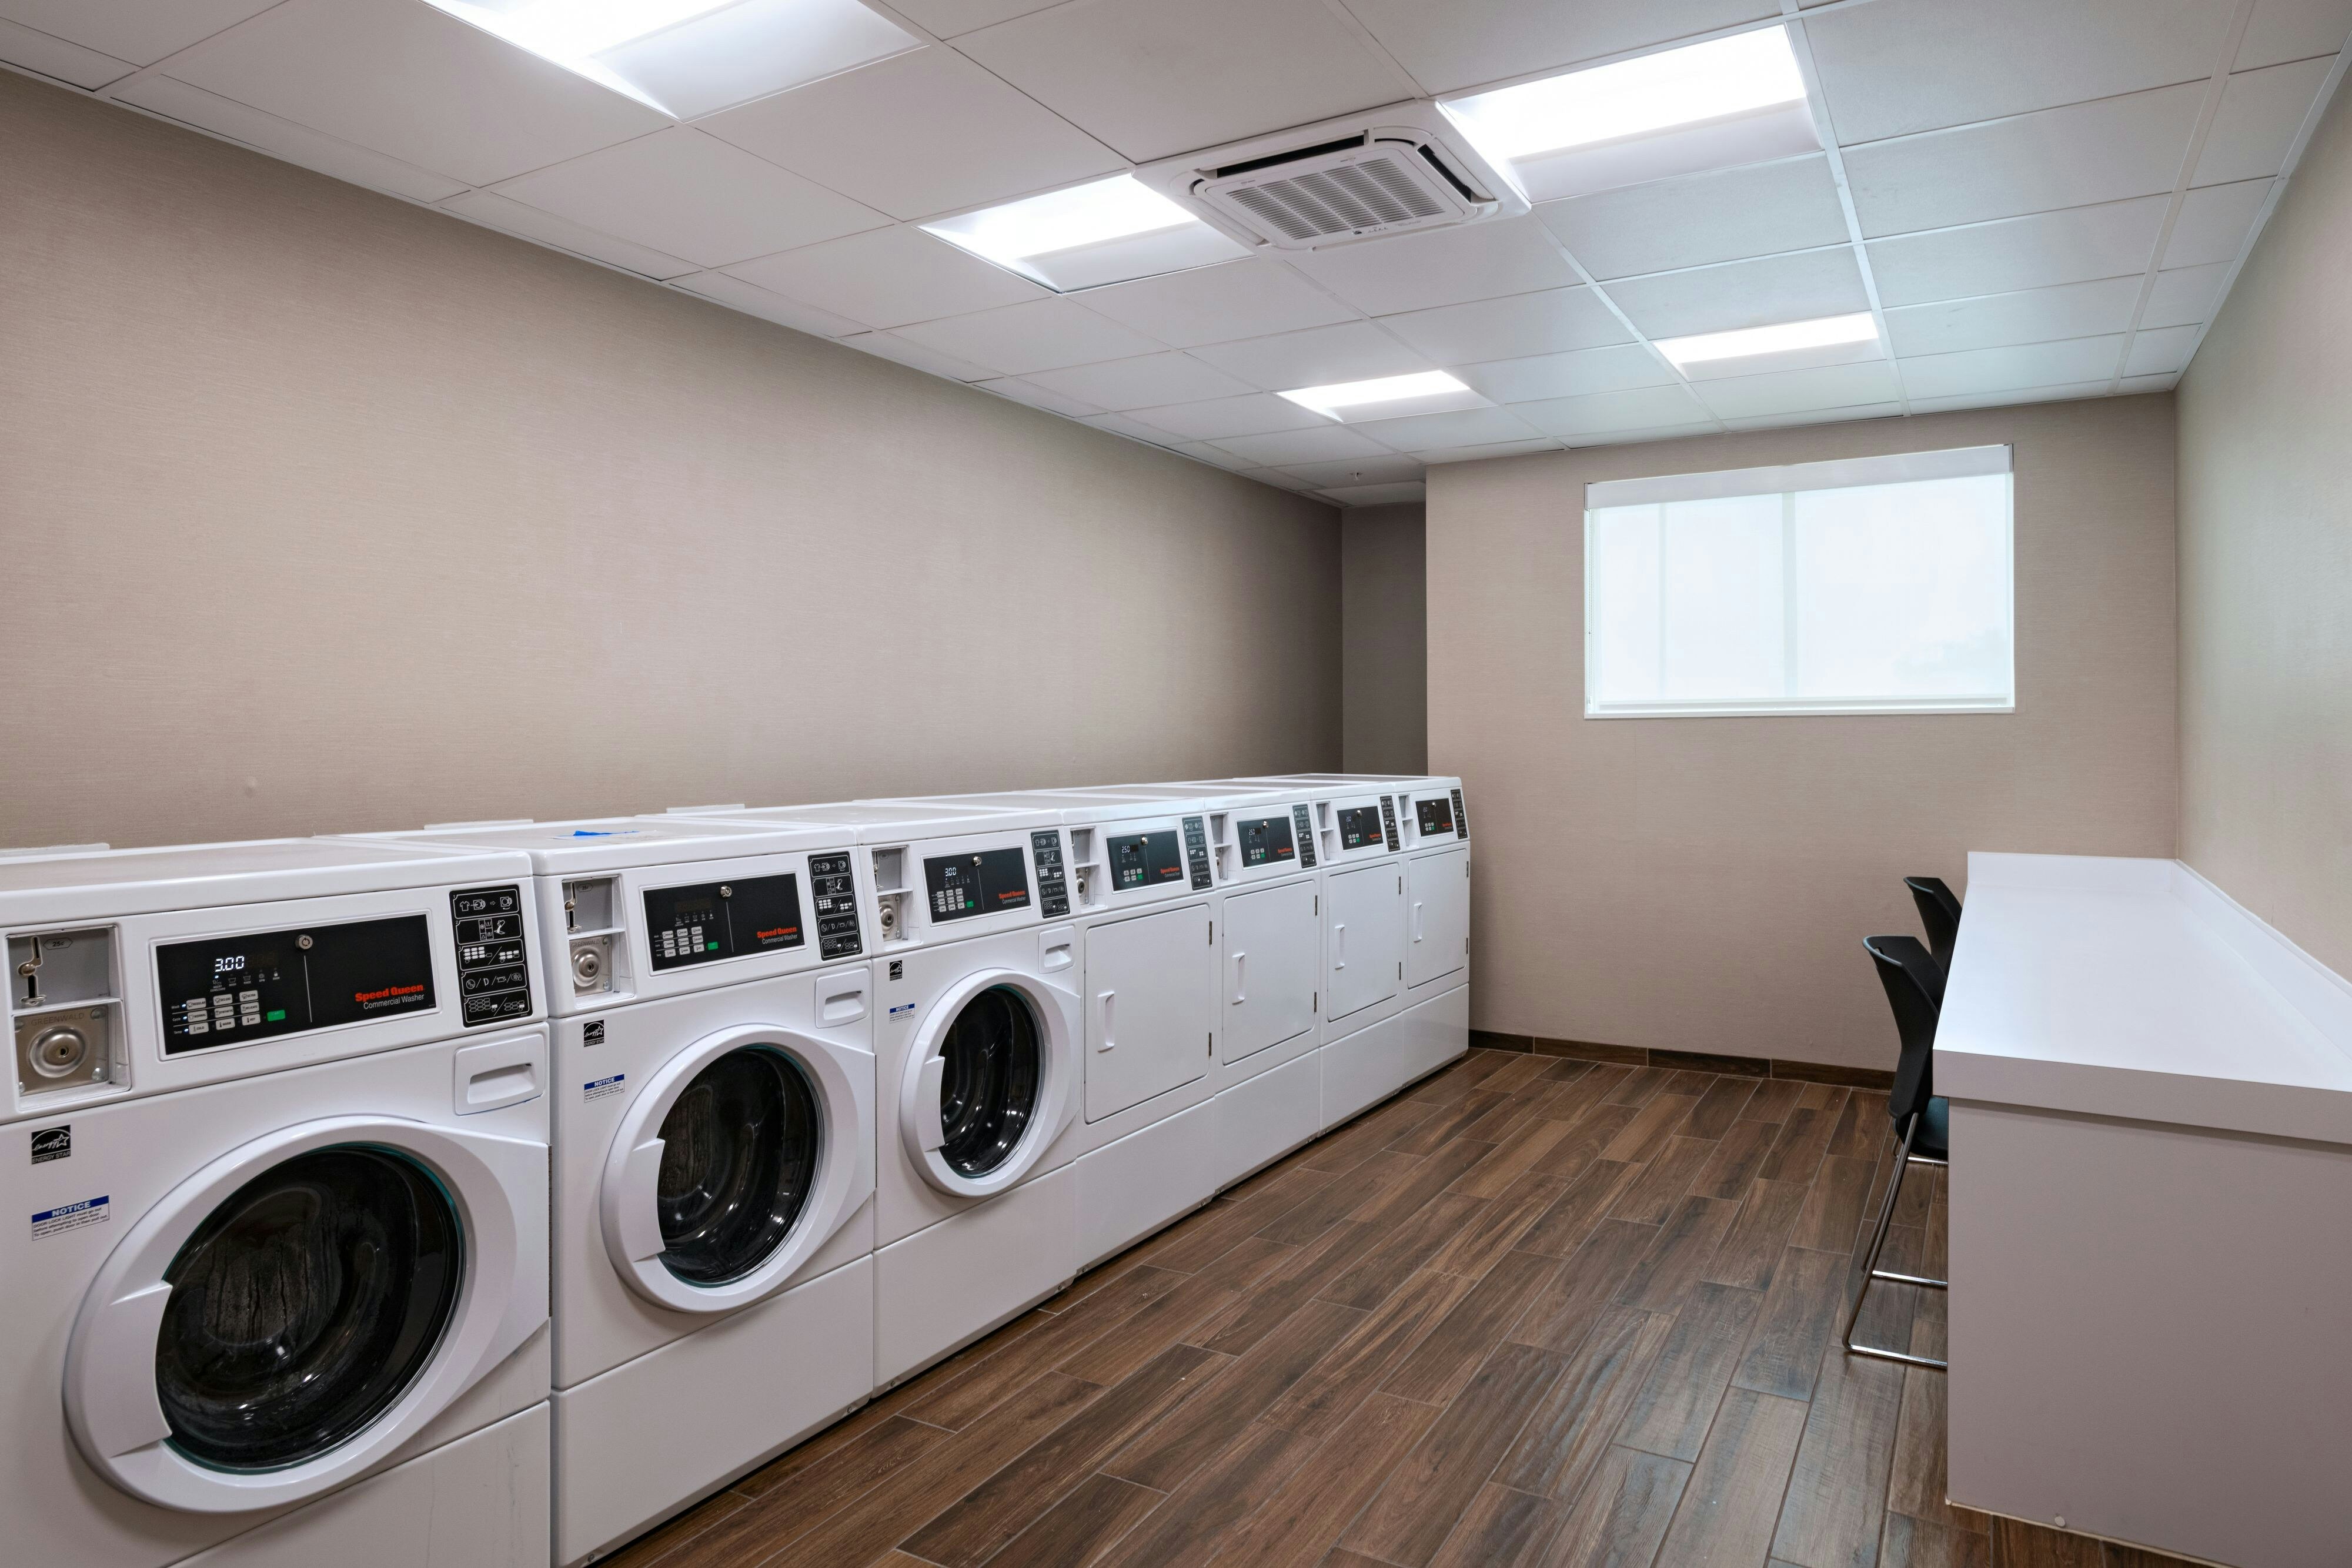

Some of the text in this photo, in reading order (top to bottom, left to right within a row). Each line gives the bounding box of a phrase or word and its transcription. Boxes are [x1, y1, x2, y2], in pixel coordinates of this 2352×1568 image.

[757, 929, 777, 938] Speed
[572, 940, 600, 948] GREENWALD
[762, 936, 784, 944] Commercial
[215, 956, 245, 972] 3.00
[355, 984, 423, 1002] Speed Queen
[363, 994, 425, 1009] Commercial Washer
[31, 1012, 85, 1026] GREENWALD
[594, 1077, 614, 1086] NOTICE
[32, 1154, 55, 1164] ENERGY
[52, 1201, 91, 1217] NOTICE
